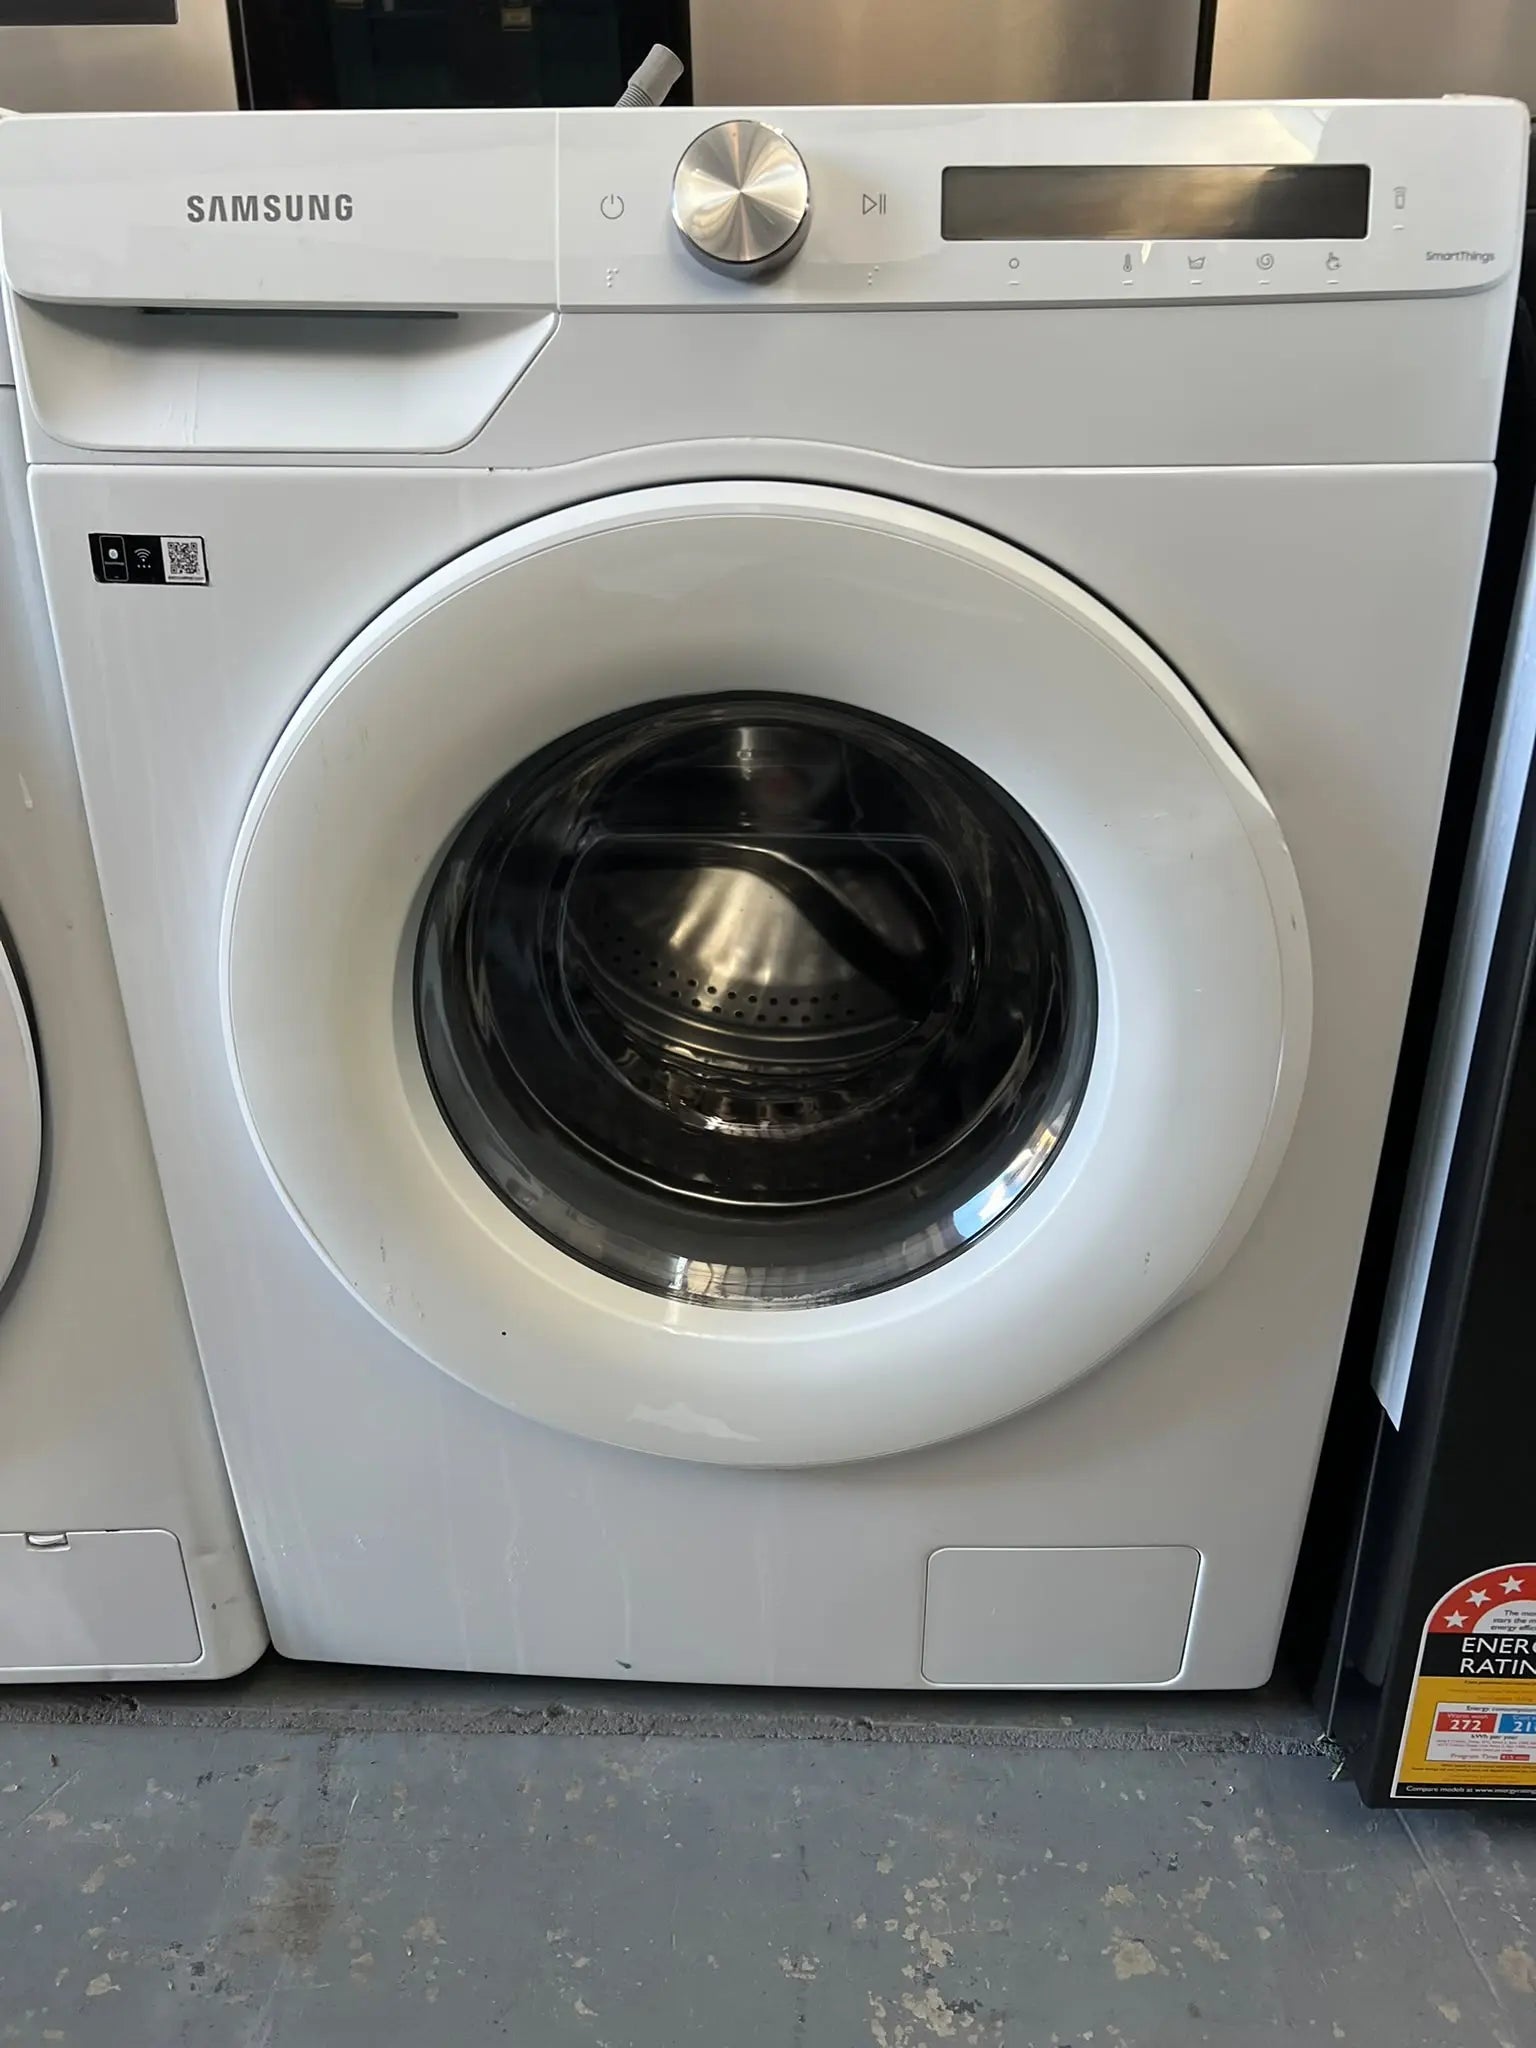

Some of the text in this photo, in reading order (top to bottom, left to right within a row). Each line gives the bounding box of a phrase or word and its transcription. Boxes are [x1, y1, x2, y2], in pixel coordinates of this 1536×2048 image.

[187, 194, 353, 223] SAMSUNG
[1426, 250, 1496, 265] SmartThings
[1505, 1609, 1519, 1617] The
[1461, 1636, 1536, 1654] ENER
[1449, 1719, 1482, 1731] 272
[1405, 1785, 1439, 1793] Compare
